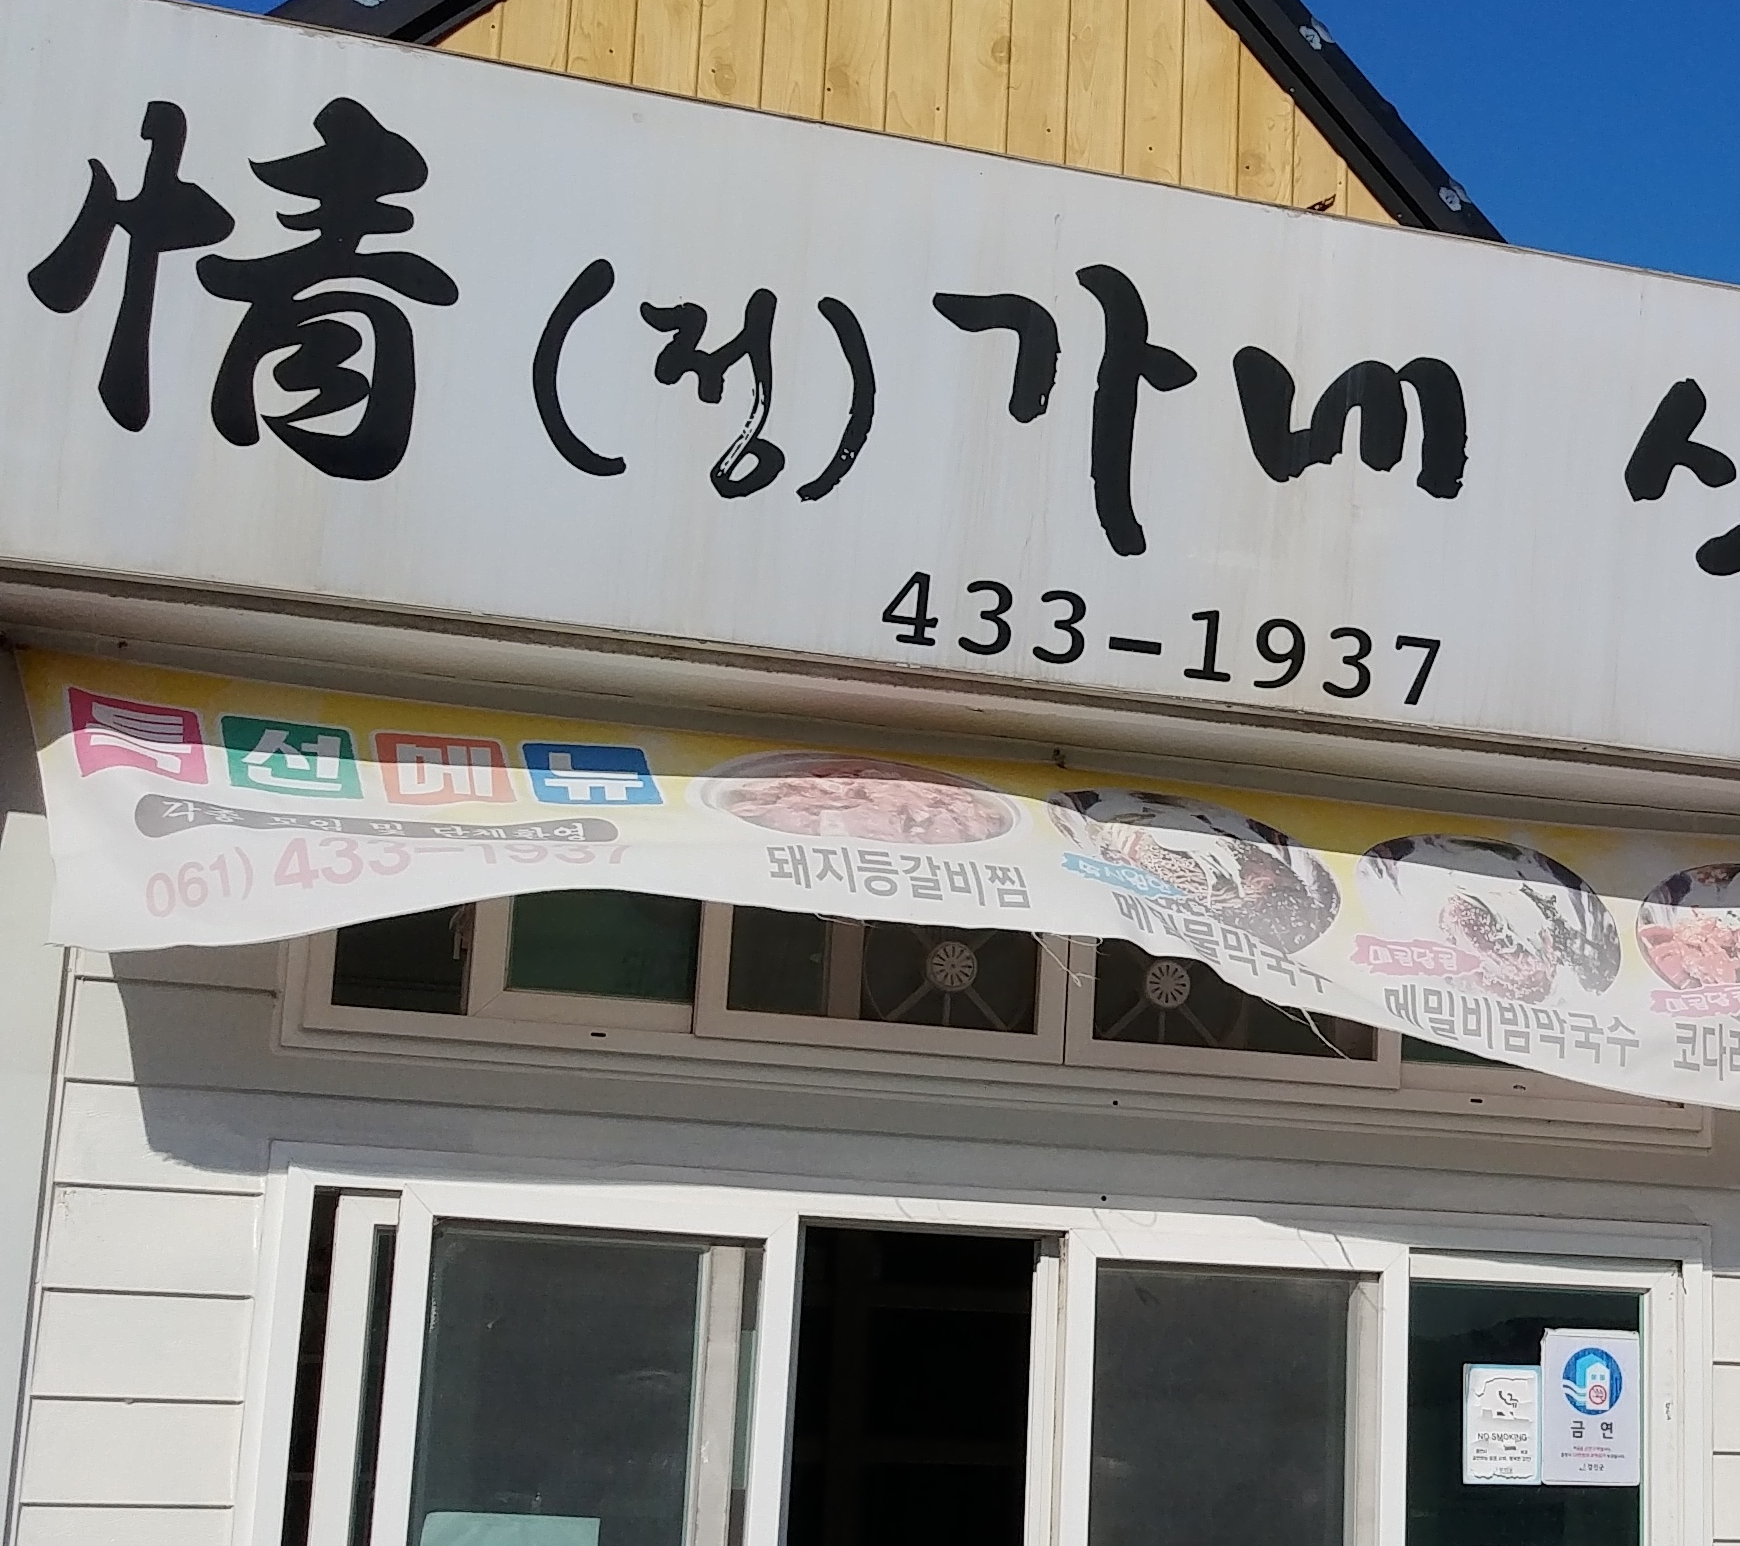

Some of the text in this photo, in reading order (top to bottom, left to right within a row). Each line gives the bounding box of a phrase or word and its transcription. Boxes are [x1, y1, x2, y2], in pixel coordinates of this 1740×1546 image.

[882, 571, 1442, 709] 433-1937
[368, 822, 406, 837] 및
[145, 846, 254, 918] 061)
[766, 844, 1031, 909] 돼지등갈비찜
[1383, 984, 1640, 1068] 메밀비빔막국수
